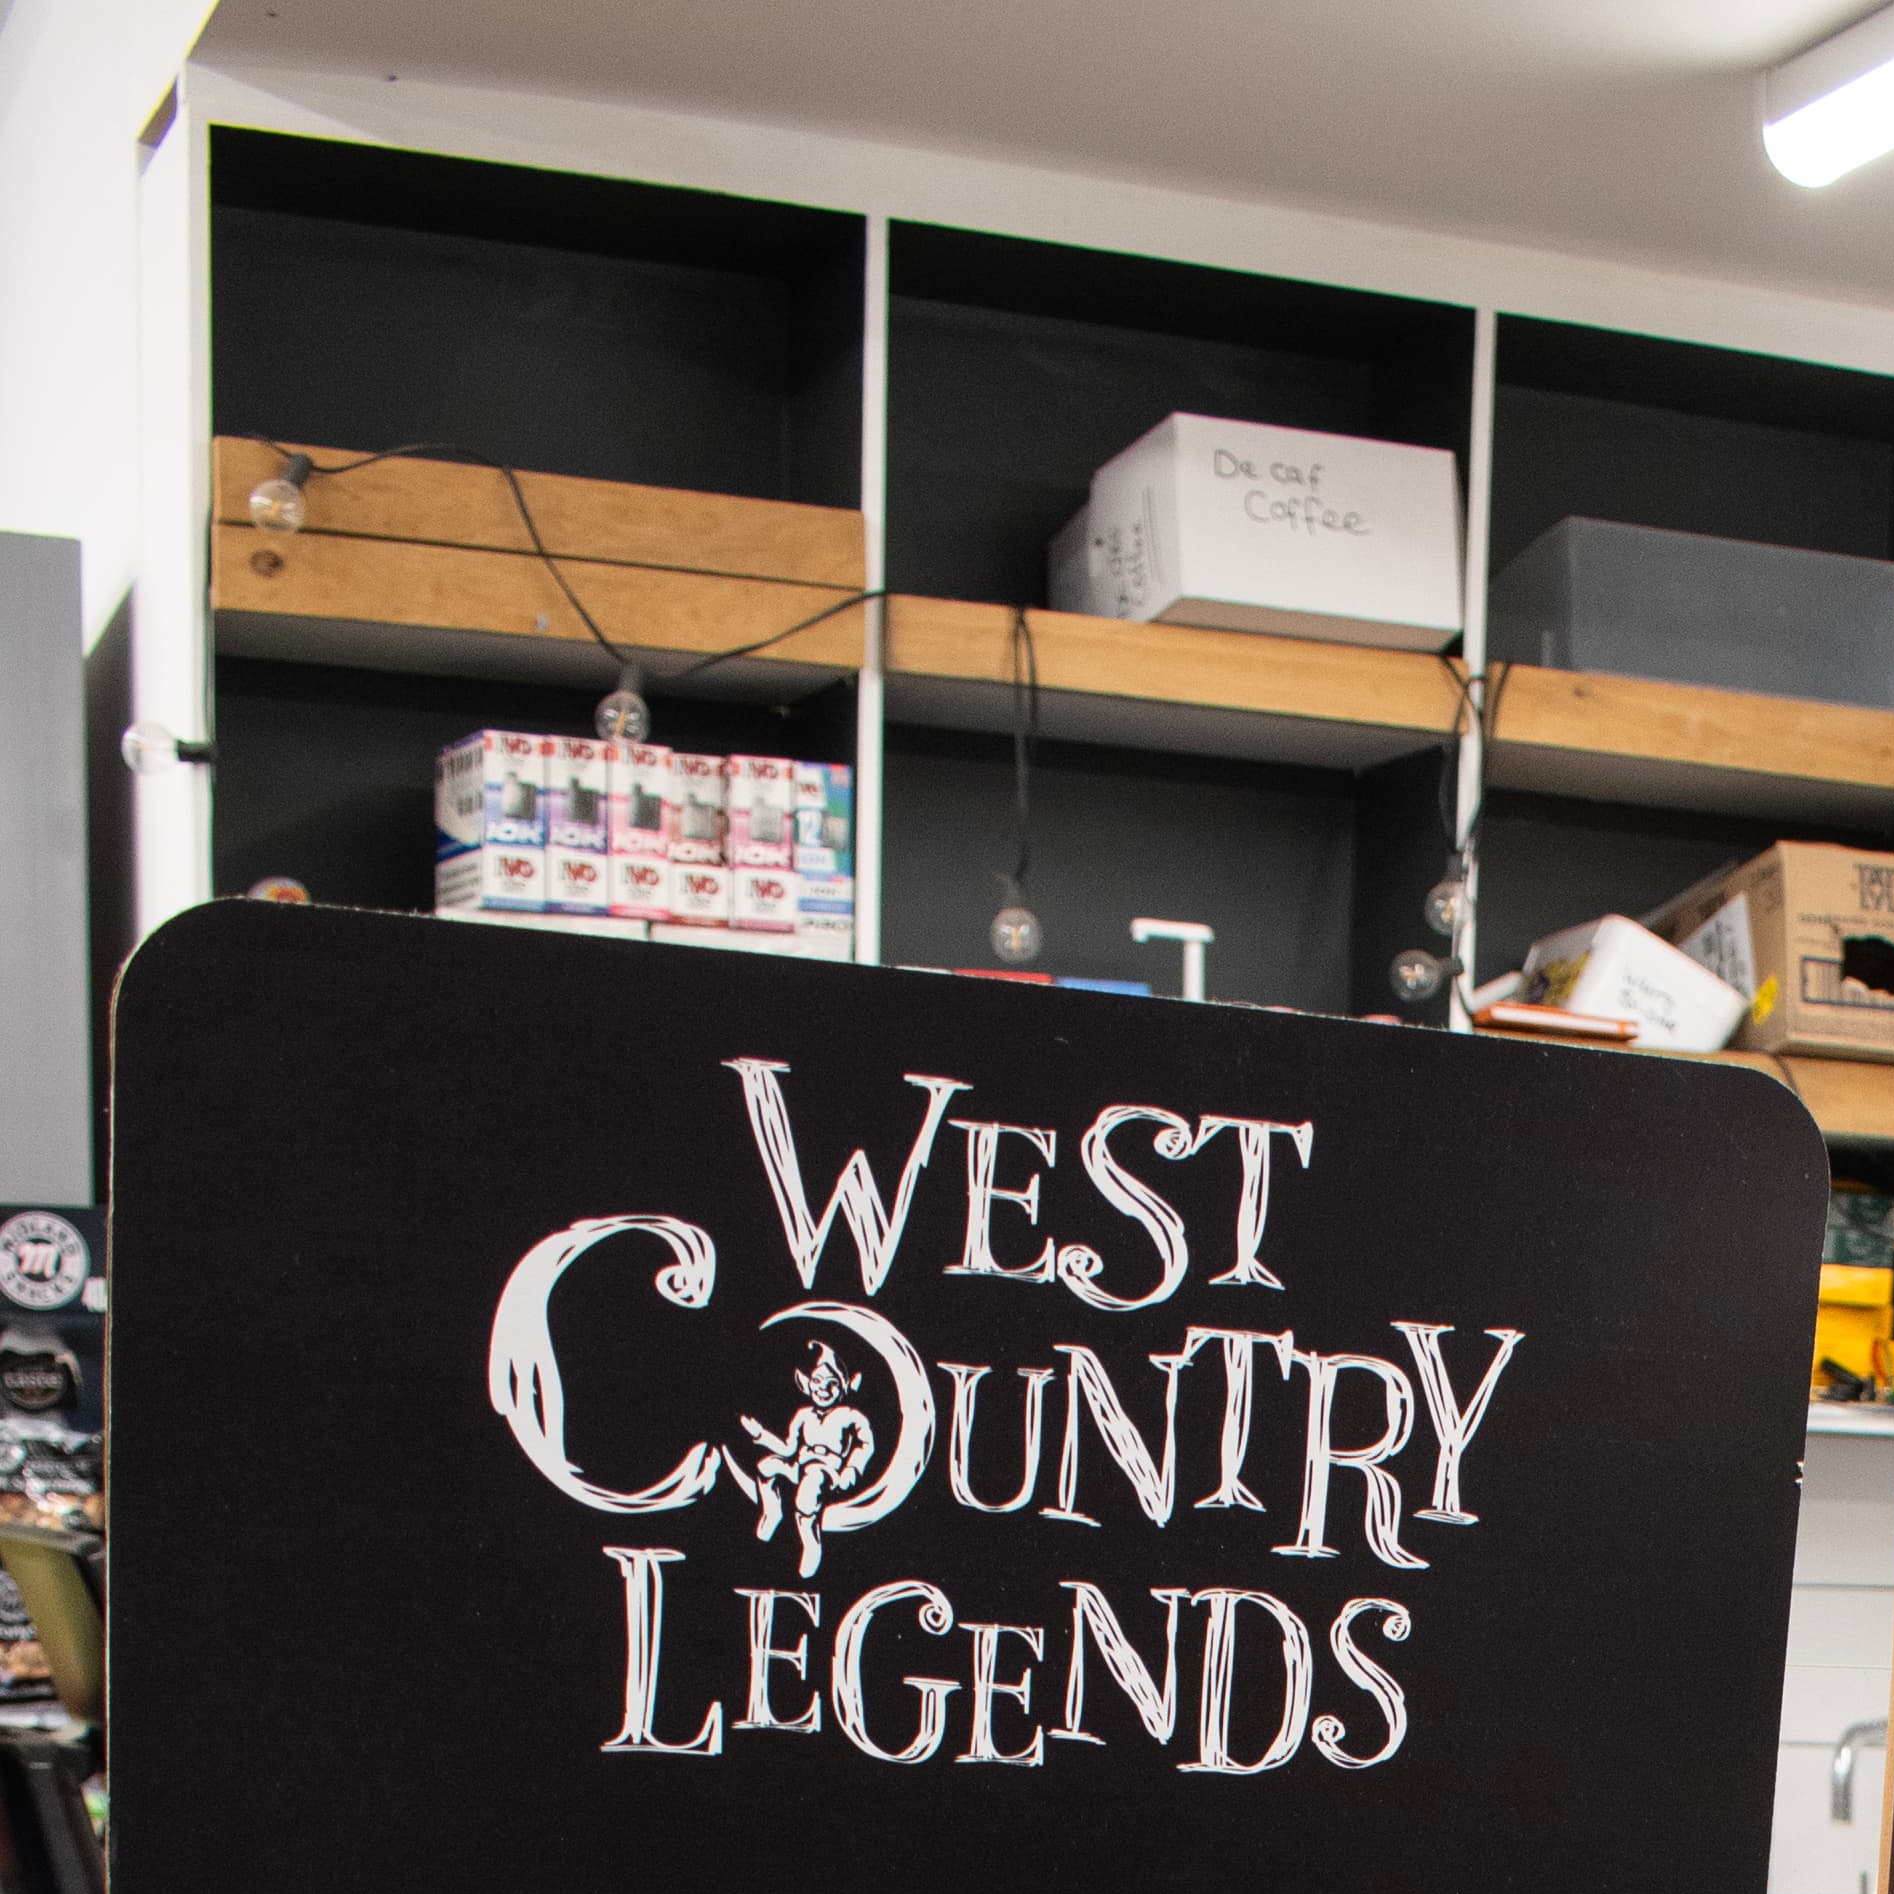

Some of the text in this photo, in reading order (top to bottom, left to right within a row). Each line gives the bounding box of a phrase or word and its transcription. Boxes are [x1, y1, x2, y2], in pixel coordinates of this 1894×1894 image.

[1243, 489, 1372, 536] Coffee
[721, 1056, 1313, 1311] WEST
[489, 1215, 1525, 1570] COUNTRY
[600, 1546, 1411, 1774] LEGENDS
